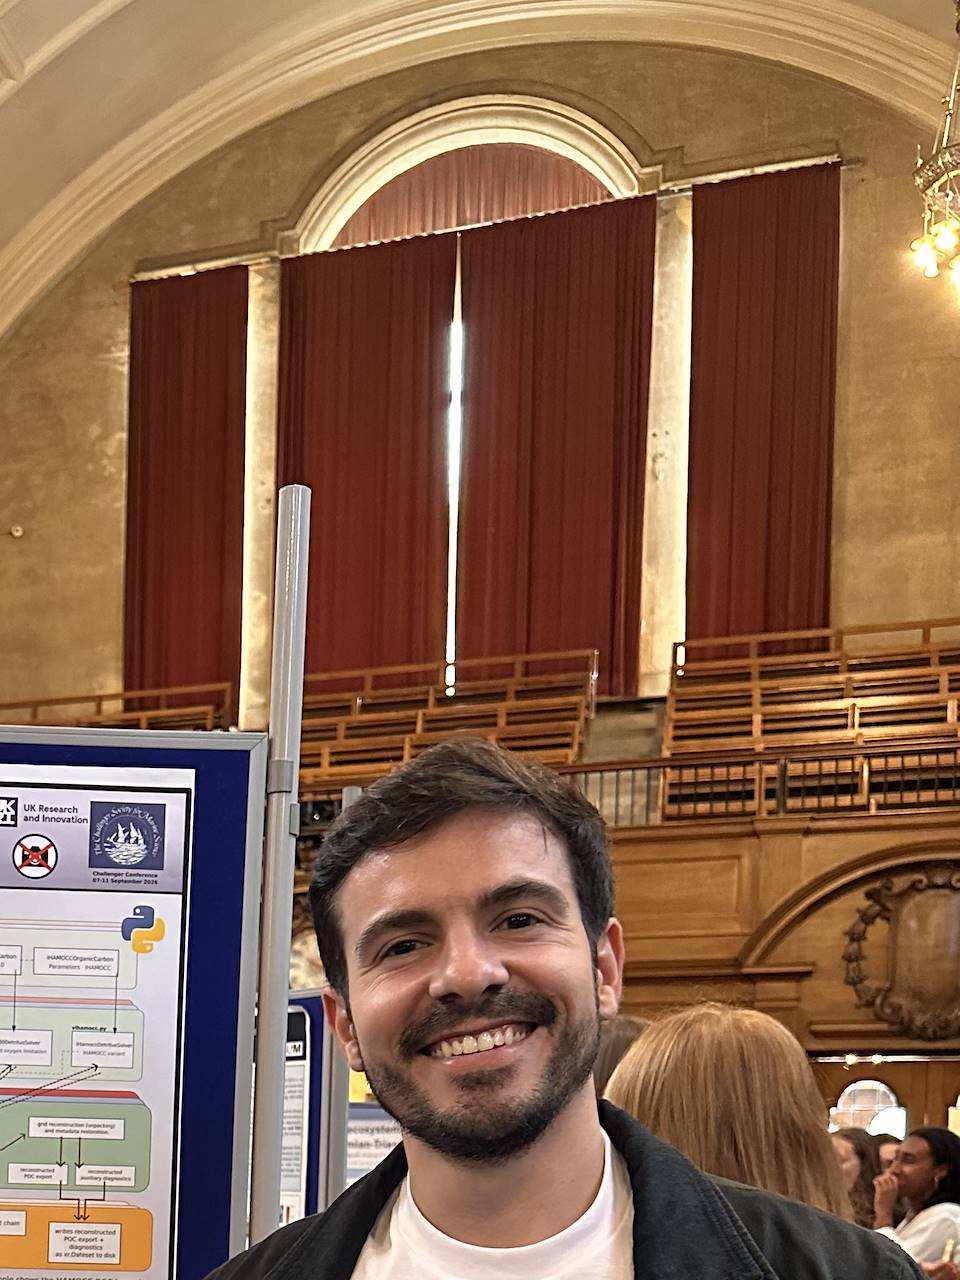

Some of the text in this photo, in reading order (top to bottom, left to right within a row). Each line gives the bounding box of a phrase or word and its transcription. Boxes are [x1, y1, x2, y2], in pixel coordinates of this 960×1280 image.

[23, 804, 78, 814] UK Research
[42, 815, 88, 824] Innovation
